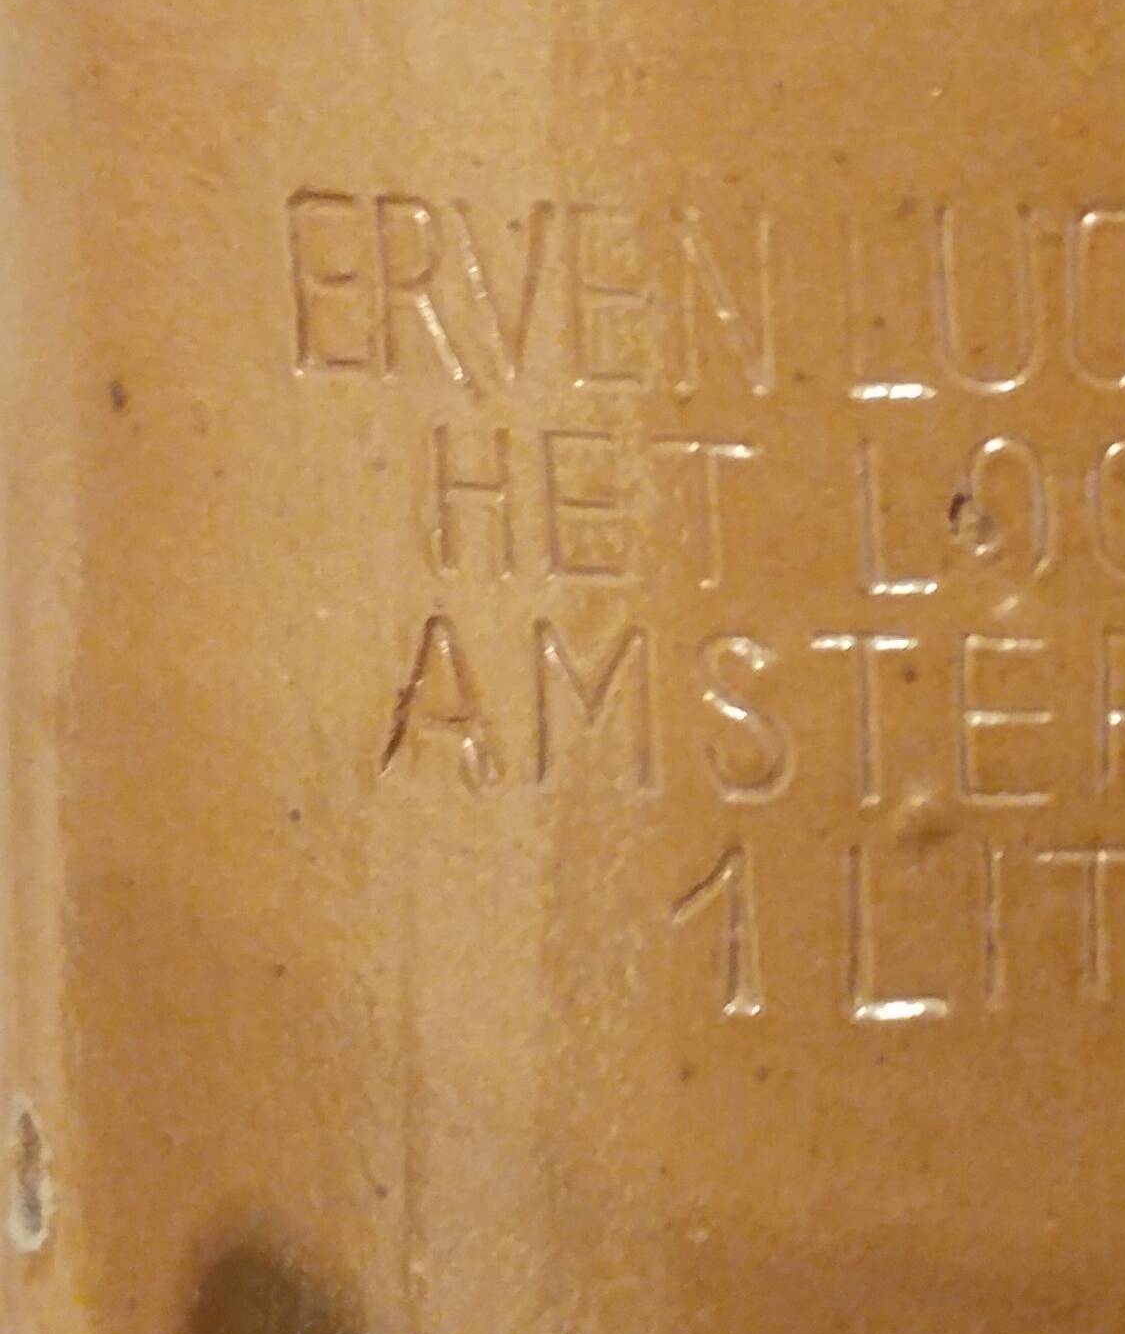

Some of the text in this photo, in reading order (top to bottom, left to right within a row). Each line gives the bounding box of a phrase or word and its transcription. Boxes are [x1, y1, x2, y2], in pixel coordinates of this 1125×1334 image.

[284, 184, 777, 401] ERVEN
[429, 421, 763, 591] HET
[669, 842, 763, 1019] 1
